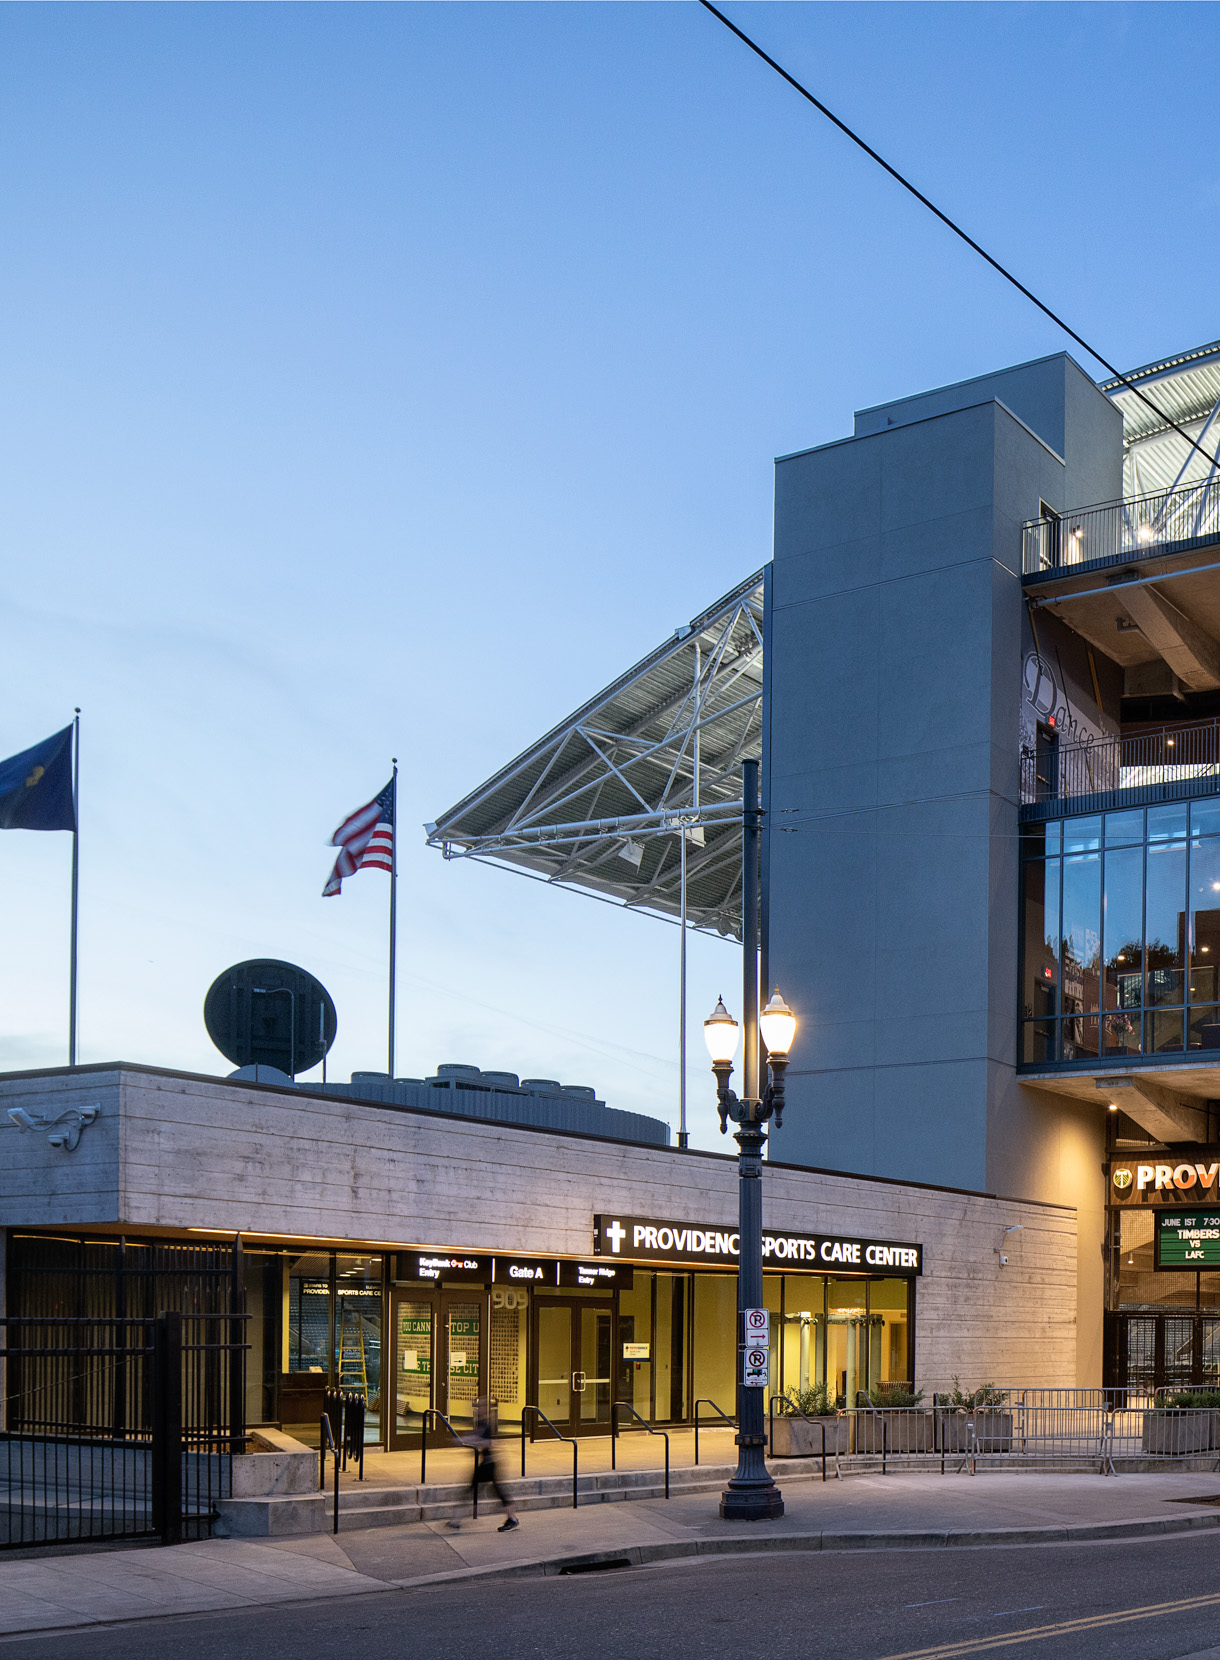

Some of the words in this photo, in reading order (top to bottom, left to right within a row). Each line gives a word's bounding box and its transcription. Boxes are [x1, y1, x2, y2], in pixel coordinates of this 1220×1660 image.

[1023, 651, 1096, 756] Dance
[1162, 1218, 1181, 1226] JUNE
[1177, 1229, 1220, 1240] TIMBERS
[634, 1225, 740, 1255] PROVIDENC
[820, 1242, 861, 1263] CARE
[866, 1246, 918, 1268] CENTER
[1190, 1240, 1201, 1248] VS
[1185, 1250, 1204, 1259] LAFC
[464, 1260, 478, 1269] Club
[419, 1268, 440, 1279] Entry
[510, 1265, 534, 1279] Gate
[534, 1267, 544, 1279] A
[578, 1276, 595, 1285] Entry
[492, 1290, 528, 1310] 909
[451, 1322, 470, 1333] TOP
[463, 1364, 479, 1374] CIT
